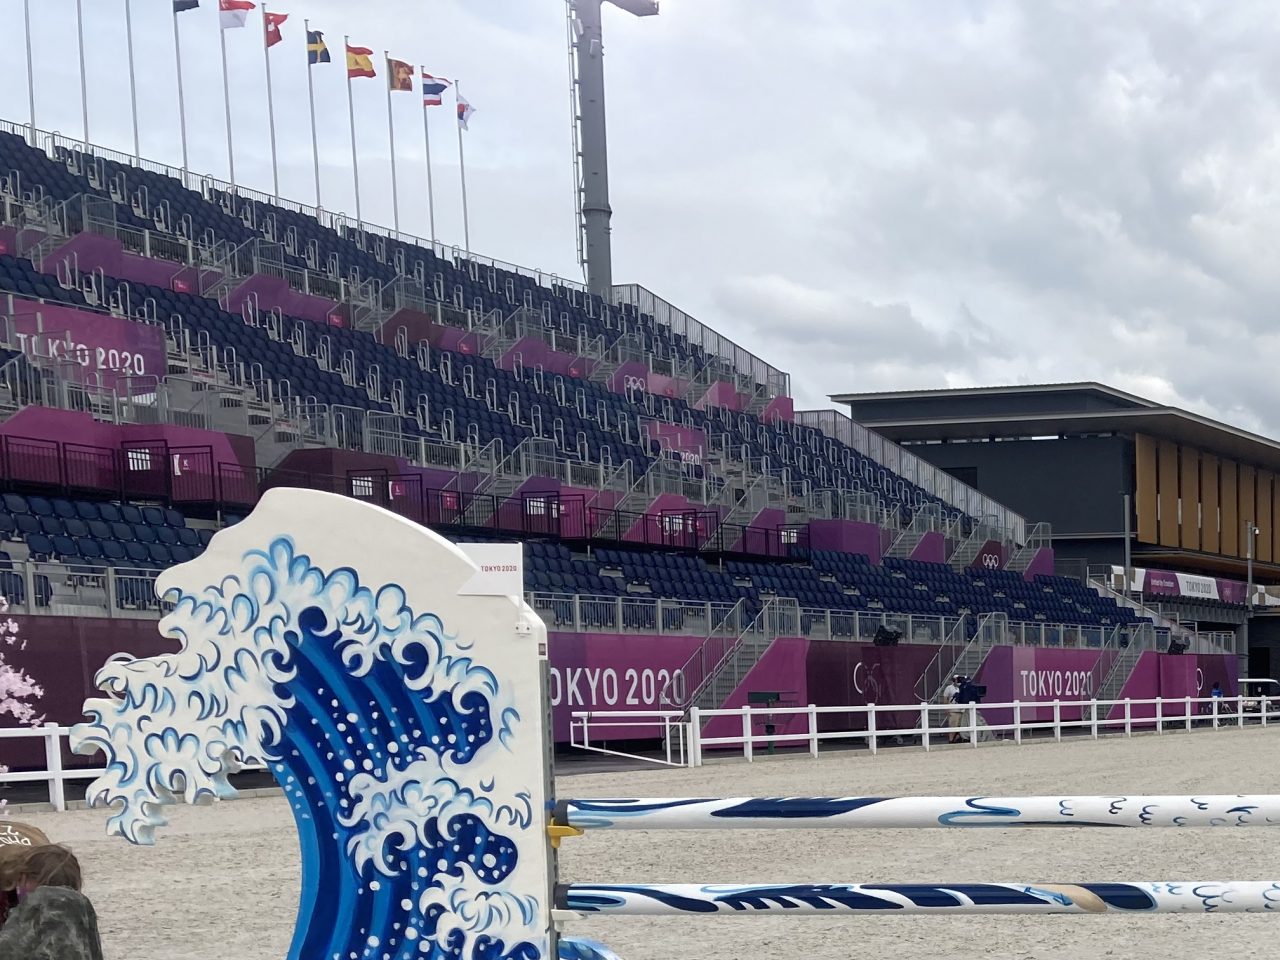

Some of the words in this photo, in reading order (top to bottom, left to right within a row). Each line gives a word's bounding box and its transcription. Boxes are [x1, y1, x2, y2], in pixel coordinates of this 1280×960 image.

[96, 346, 145, 376] 2020
[550, 667, 618, 706] OKYO
[625, 668, 686, 705] 2020
[1020, 670, 1062, 697] TOKYO
[1065, 671, 1093, 697] 2020
